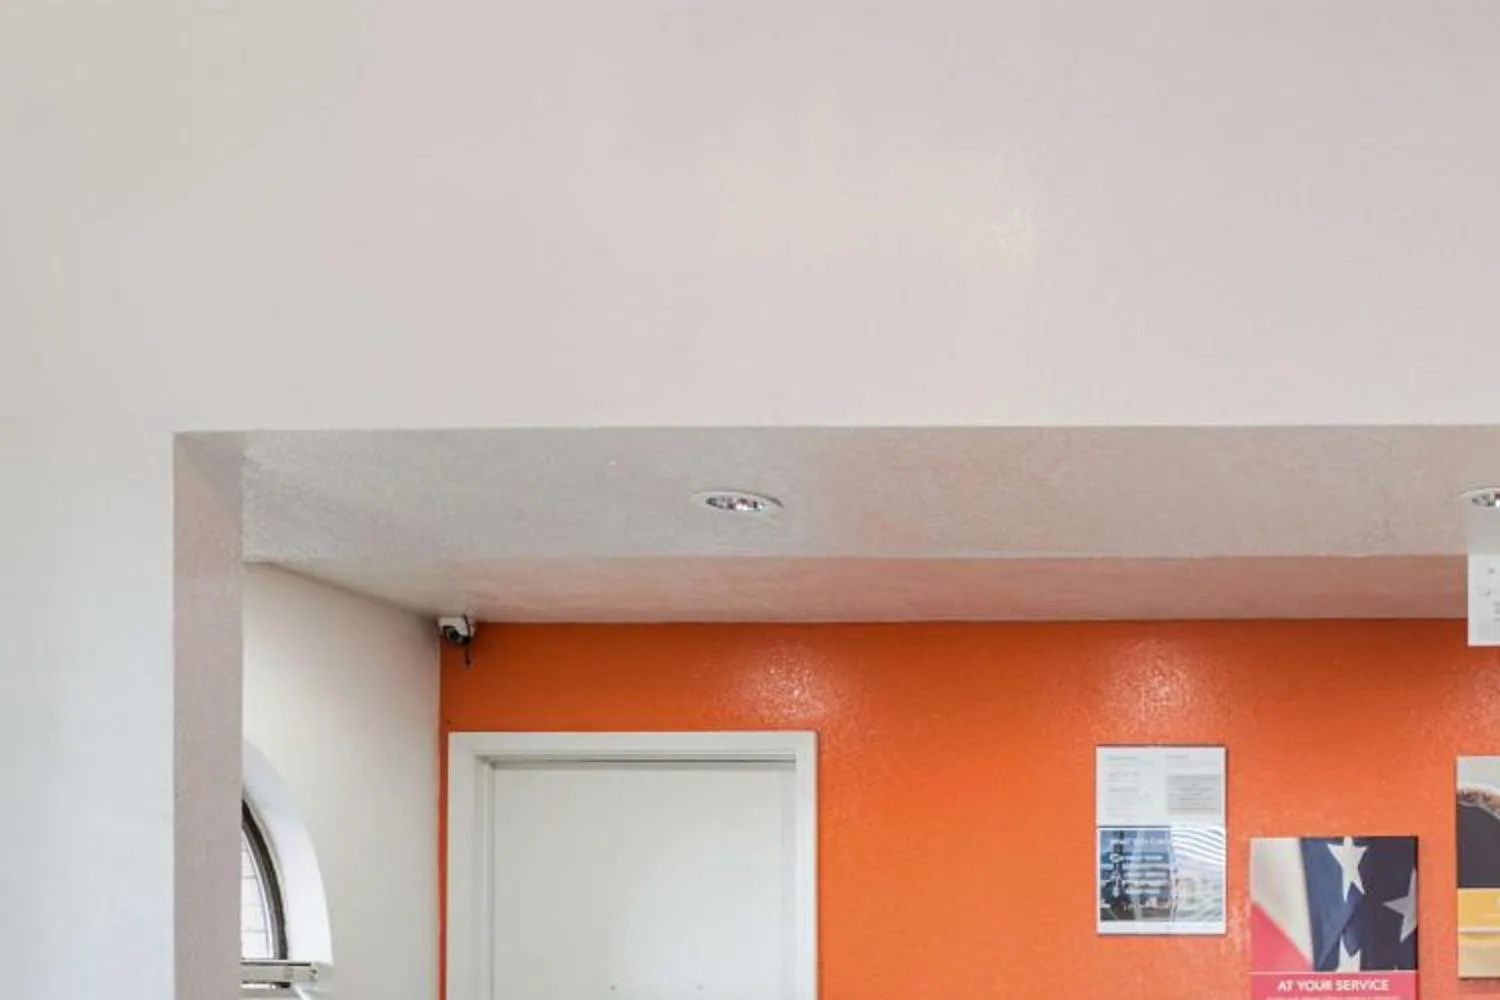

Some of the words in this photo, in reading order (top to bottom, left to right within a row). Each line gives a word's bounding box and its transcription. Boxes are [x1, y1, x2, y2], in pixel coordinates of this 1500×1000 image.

[1277, 980, 1294, 991] AT
[1299, 980, 1332, 991] YOUR
[1336, 979, 1389, 991] SERVICE
